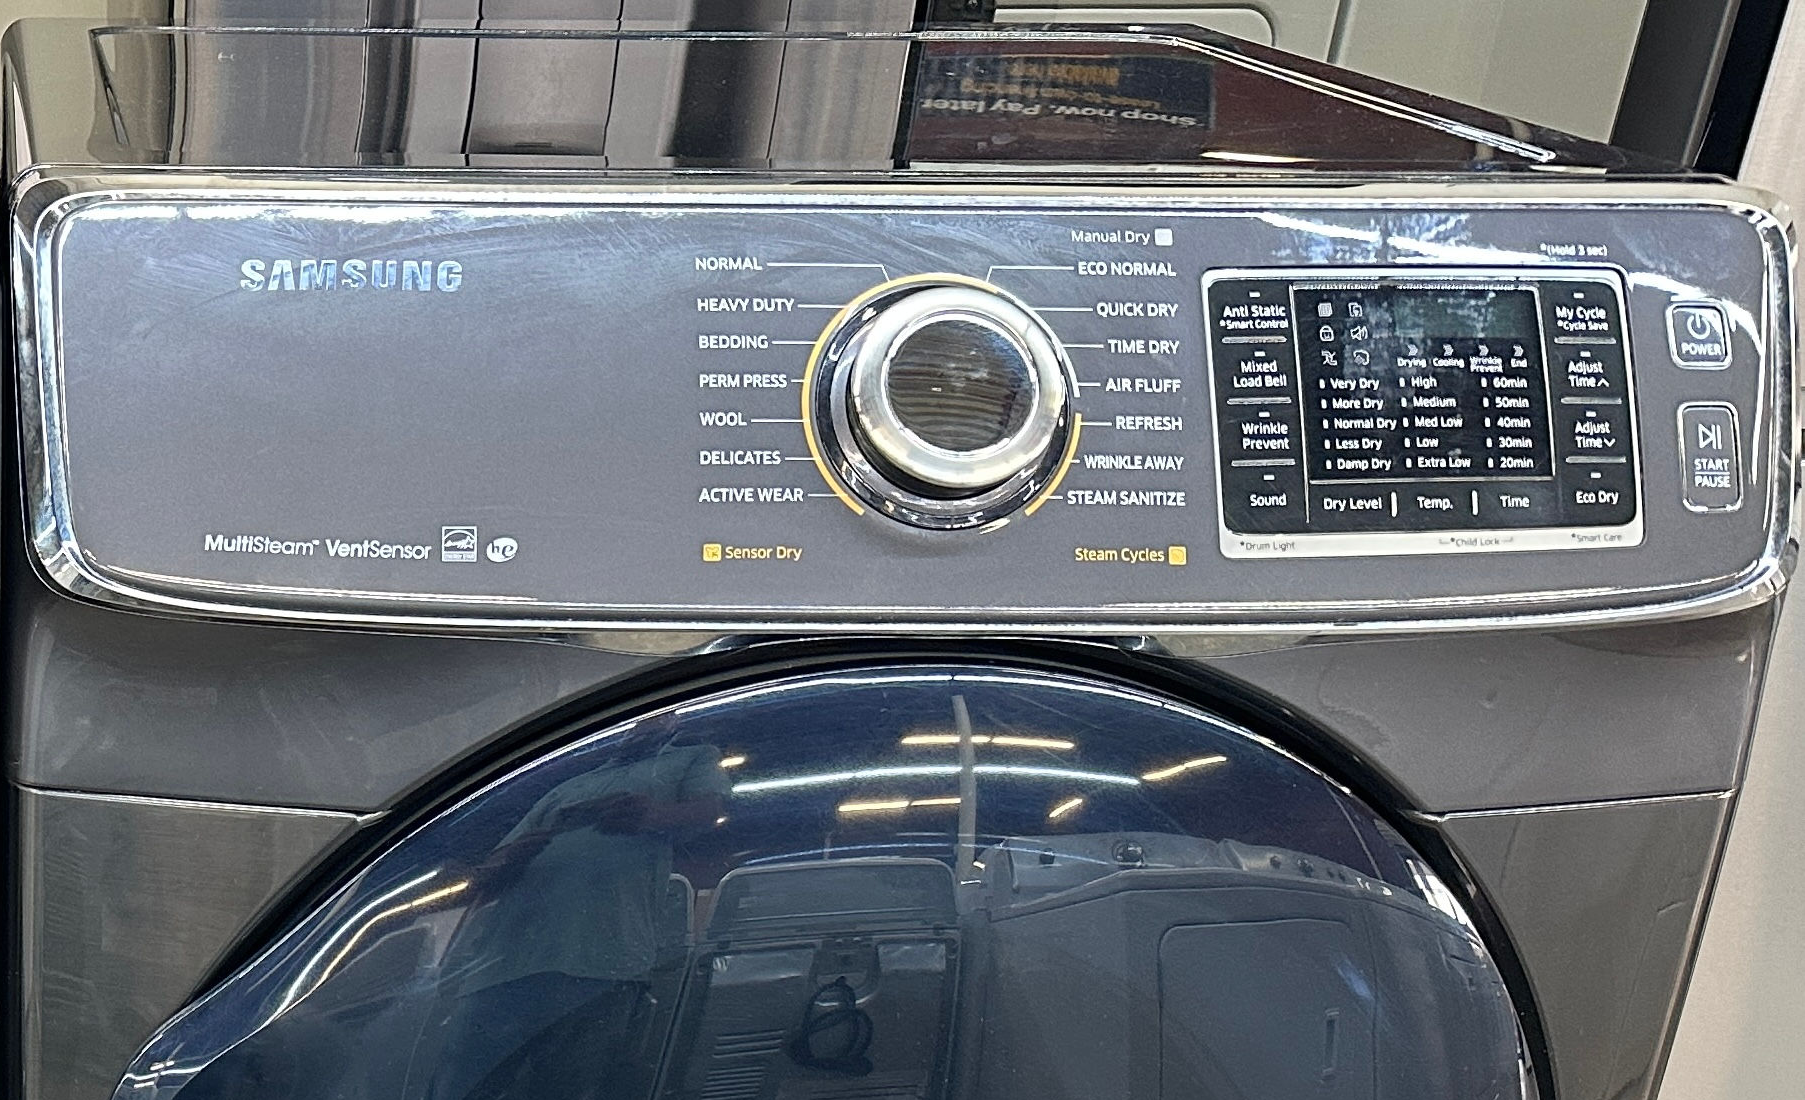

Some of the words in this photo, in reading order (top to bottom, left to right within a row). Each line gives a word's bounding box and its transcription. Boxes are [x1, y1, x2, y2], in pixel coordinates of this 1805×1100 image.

[1071, 229, 1120, 242] Manual
[1125, 231, 1150, 245] Dry
[696, 257, 763, 270] NORMAL
[1078, 262, 1107, 275] ECO
[1111, 262, 1177, 276] NORMAL
[240, 259, 462, 292] SAMSUNG
[697, 298, 749, 311] HEAVY
[753, 298, 794, 311] DUTY
[1097, 302, 1144, 317] QUICK
[1147, 303, 1178, 317] DRY
[1224, 305, 1248, 317] Anti
[1251, 304, 1285, 317] Static
[1556, 306, 1573, 320] My
[1576, 306, 1606, 320] Cycle
[699, 335, 768, 349] BEDDING
[1108, 339, 1145, 353] TIME
[1149, 340, 1179, 354] DRY
[1682, 343, 1721, 355] POWER
[1241, 360, 1277, 373] Mixed
[1568, 361, 1603, 374] Adjust
[700, 374, 739, 387] PERM
[744, 374, 787, 388] PRESS
[1106, 378, 1132, 392] AIR
[1135, 378, 1181, 392] FLUFF
[1234, 375, 1262, 387] Load
[1265, 375, 1286, 386] Bell
[1330, 378, 1356, 390] Very
[1359, 378, 1379, 390] Dry
[1411, 376, 1437, 389] High
[1493, 377, 1527, 388] 60min
[1568, 375, 1596, 387] Time
[1333, 398, 1360, 408] More
[1364, 398, 1383, 410] Dry
[1413, 396, 1456, 407] Medium
[1496, 397, 1529, 407] 50min
[700, 412, 747, 426] WOOL
[1116, 416, 1182, 430] REFRESH
[1334, 418, 1373, 429] Normal
[1377, 418, 1396, 430] Dry
[1415, 416, 1438, 427] Med
[1441, 417, 1462, 427] Low
[1497, 417, 1530, 427] 40min
[1242, 422, 1288, 434] Wrinkle
[1575, 421, 1610, 435] Adjust
[1243, 438, 1289, 449] Prevent
[1336, 439, 1359, 449] Less
[1362, 438, 1382, 450] Dry
[1416, 437, 1438, 447] Low
[1499, 437, 1532, 448] 30min
[1576, 436, 1602, 448] Time
[700, 450, 781, 465] DELICATES
[1084, 455, 1142, 469] WRINKLE
[1144, 456, 1184, 470] AWAY
[1337, 459, 1368, 470] Damp
[1372, 458, 1391, 470] Dry
[1418, 457, 1446, 467] Extra
[1449, 457, 1470, 467] Low
[1500, 457, 1533, 468] 20min
[1695, 458, 1729, 471] START
[1695, 476, 1731, 487] PAUSE
[699, 488, 754, 502] ACTIVE
[757, 488, 803, 502] WEAR
[1068, 490, 1116, 505] STEAM
[1120, 491, 1185, 506] SANITIZE
[1250, 493, 1286, 506] Sound
[1500, 496, 1529, 507] Time
[1576, 491, 1595, 503] Eco
[1598, 491, 1618, 504] Dry
[1324, 498, 1346, 511] Dry
[1350, 497, 1382, 509] Level
[1417, 497, 1453, 510] Temp.
[326, 539, 432, 559] VentSensor
[726, 547, 773, 558] Sensor
[777, 546, 802, 561] Dry
[1075, 548, 1117, 561] Steam
[1120, 548, 1164, 563] Cycles
